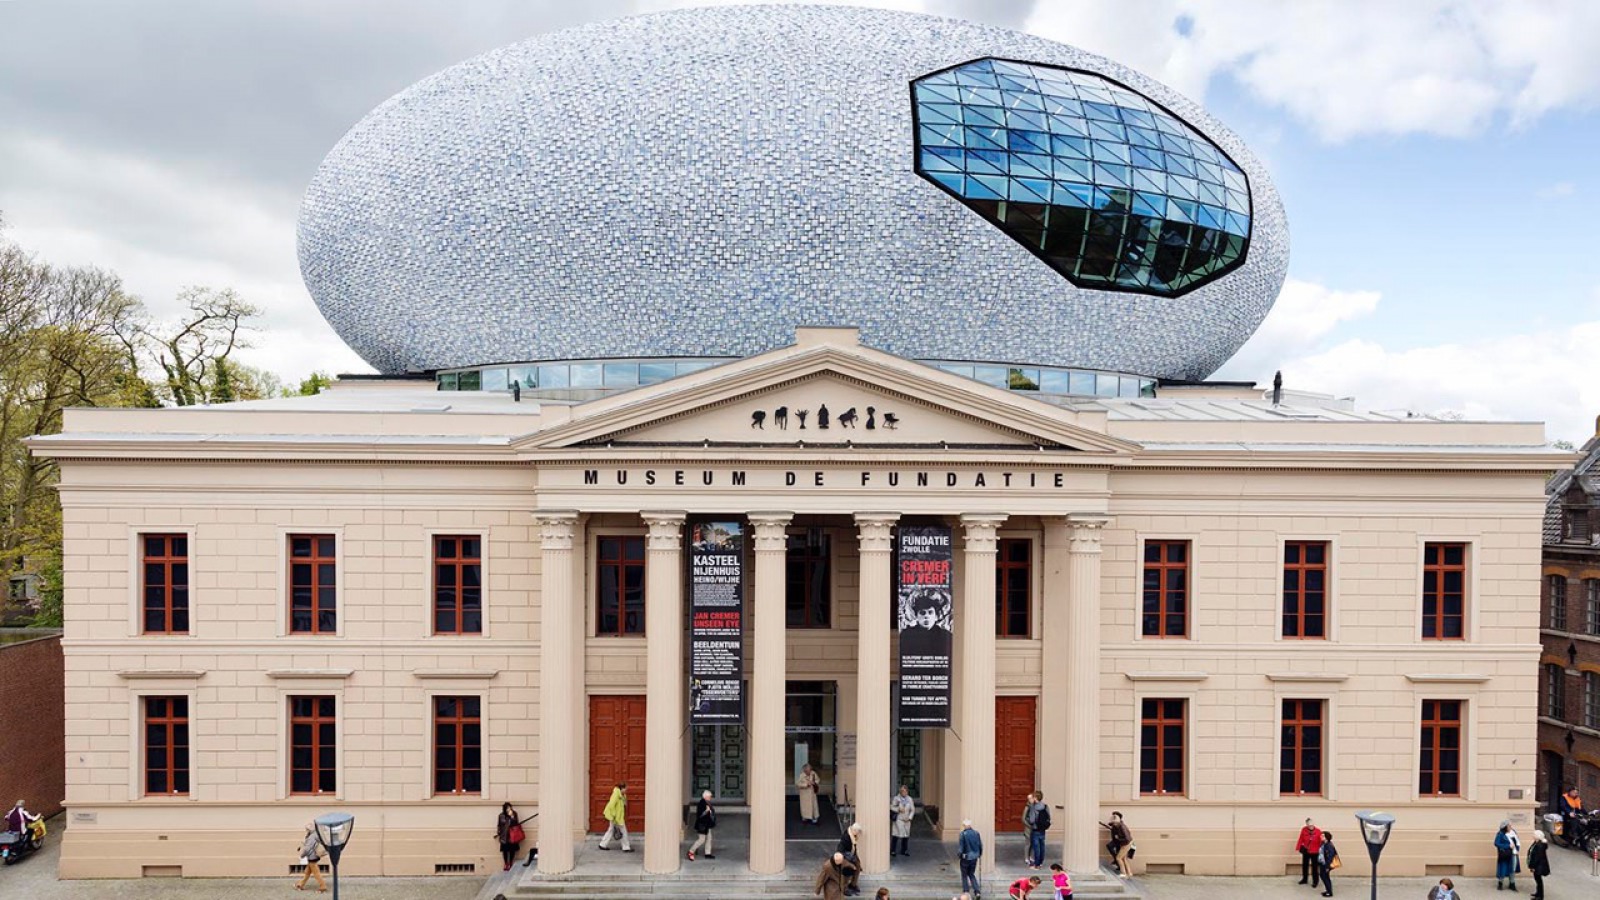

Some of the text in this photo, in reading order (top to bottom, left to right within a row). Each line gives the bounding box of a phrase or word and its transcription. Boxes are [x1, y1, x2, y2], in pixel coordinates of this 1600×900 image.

[585, 470, 1063, 487] MUSEUM DE FUNDATIE
[902, 535, 949, 546] FUNDATIE
[902, 545, 930, 553] ZWOLLE
[693, 555, 740, 566] KASTEEL
[693, 566, 740, 576] NIJENHUIS
[902, 560, 949, 572] CREMER
[902, 572, 916, 584] IN
[693, 612, 740, 620] JAN CREMER
[693, 620, 724, 628] UNSEEN
[693, 641, 740, 649] BEELDENTUIN
